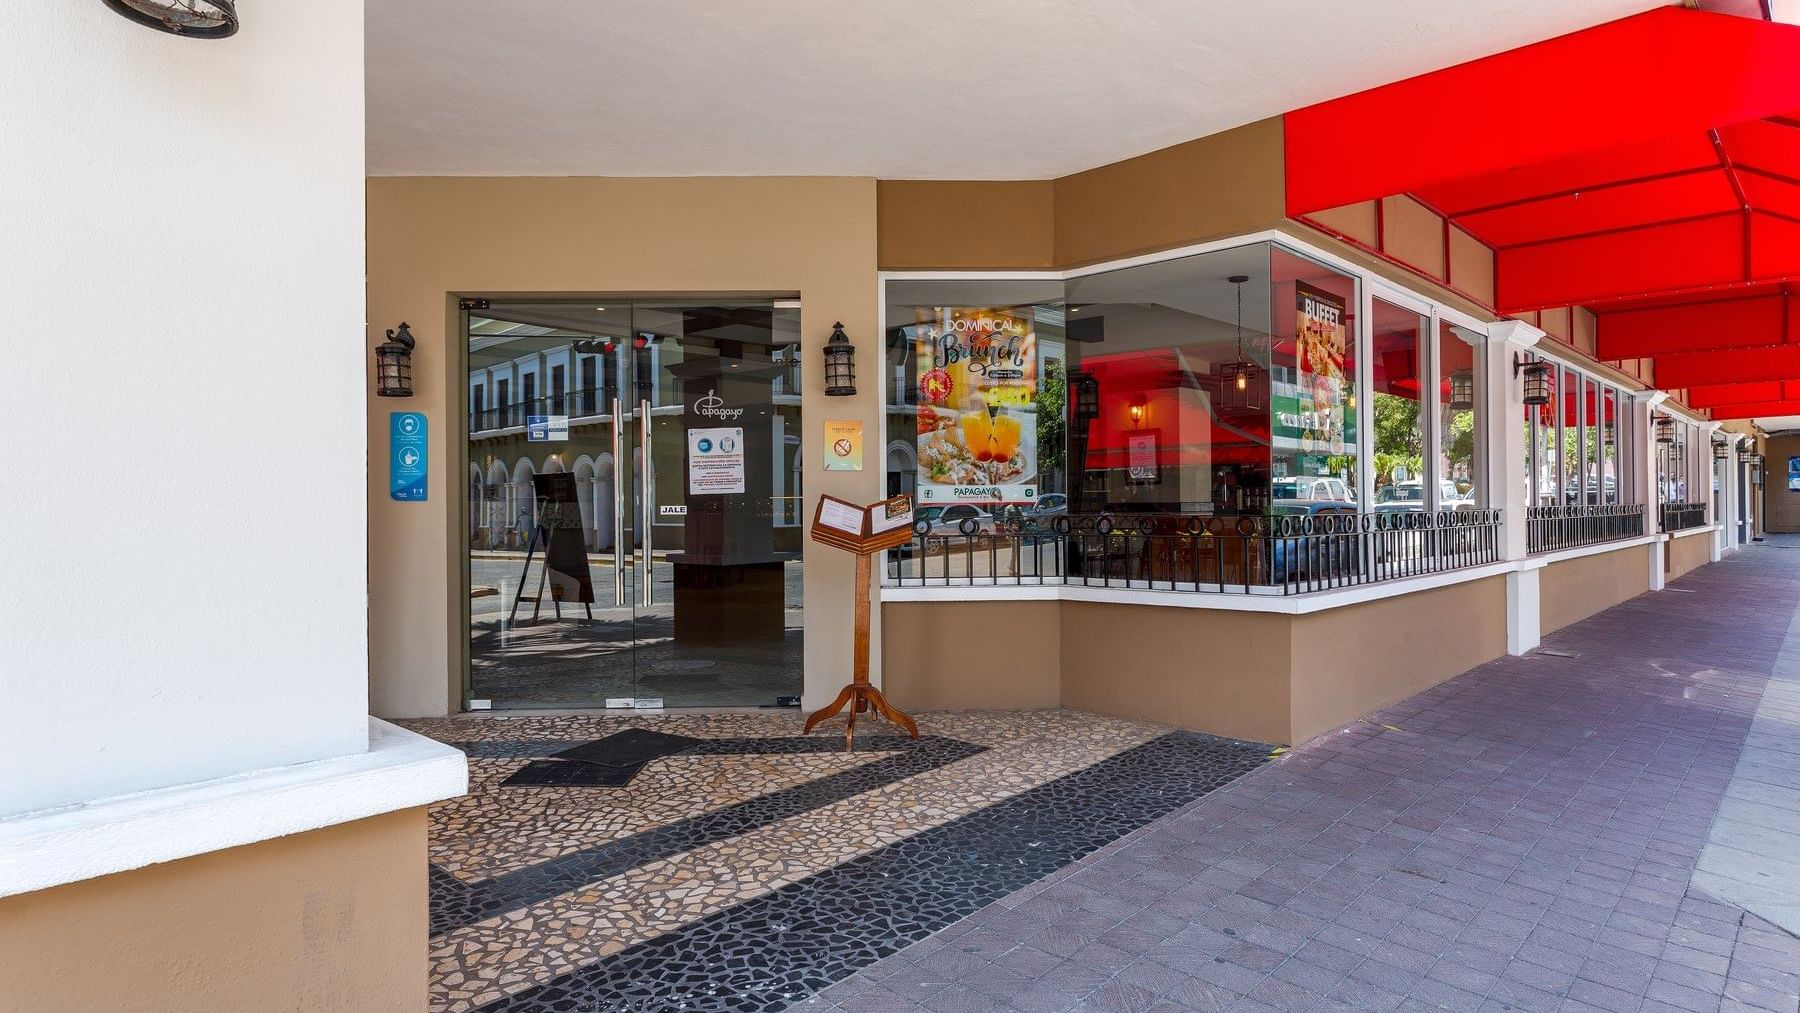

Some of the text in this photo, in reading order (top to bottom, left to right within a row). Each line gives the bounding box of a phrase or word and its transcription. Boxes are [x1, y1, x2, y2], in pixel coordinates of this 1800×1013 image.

[946, 319, 1014, 332] DOMINICAL
[1304, 298, 1340, 328] BUFFET
[934, 332, 1024, 375] Brunch
[693, 389, 744, 420] Papagayo
